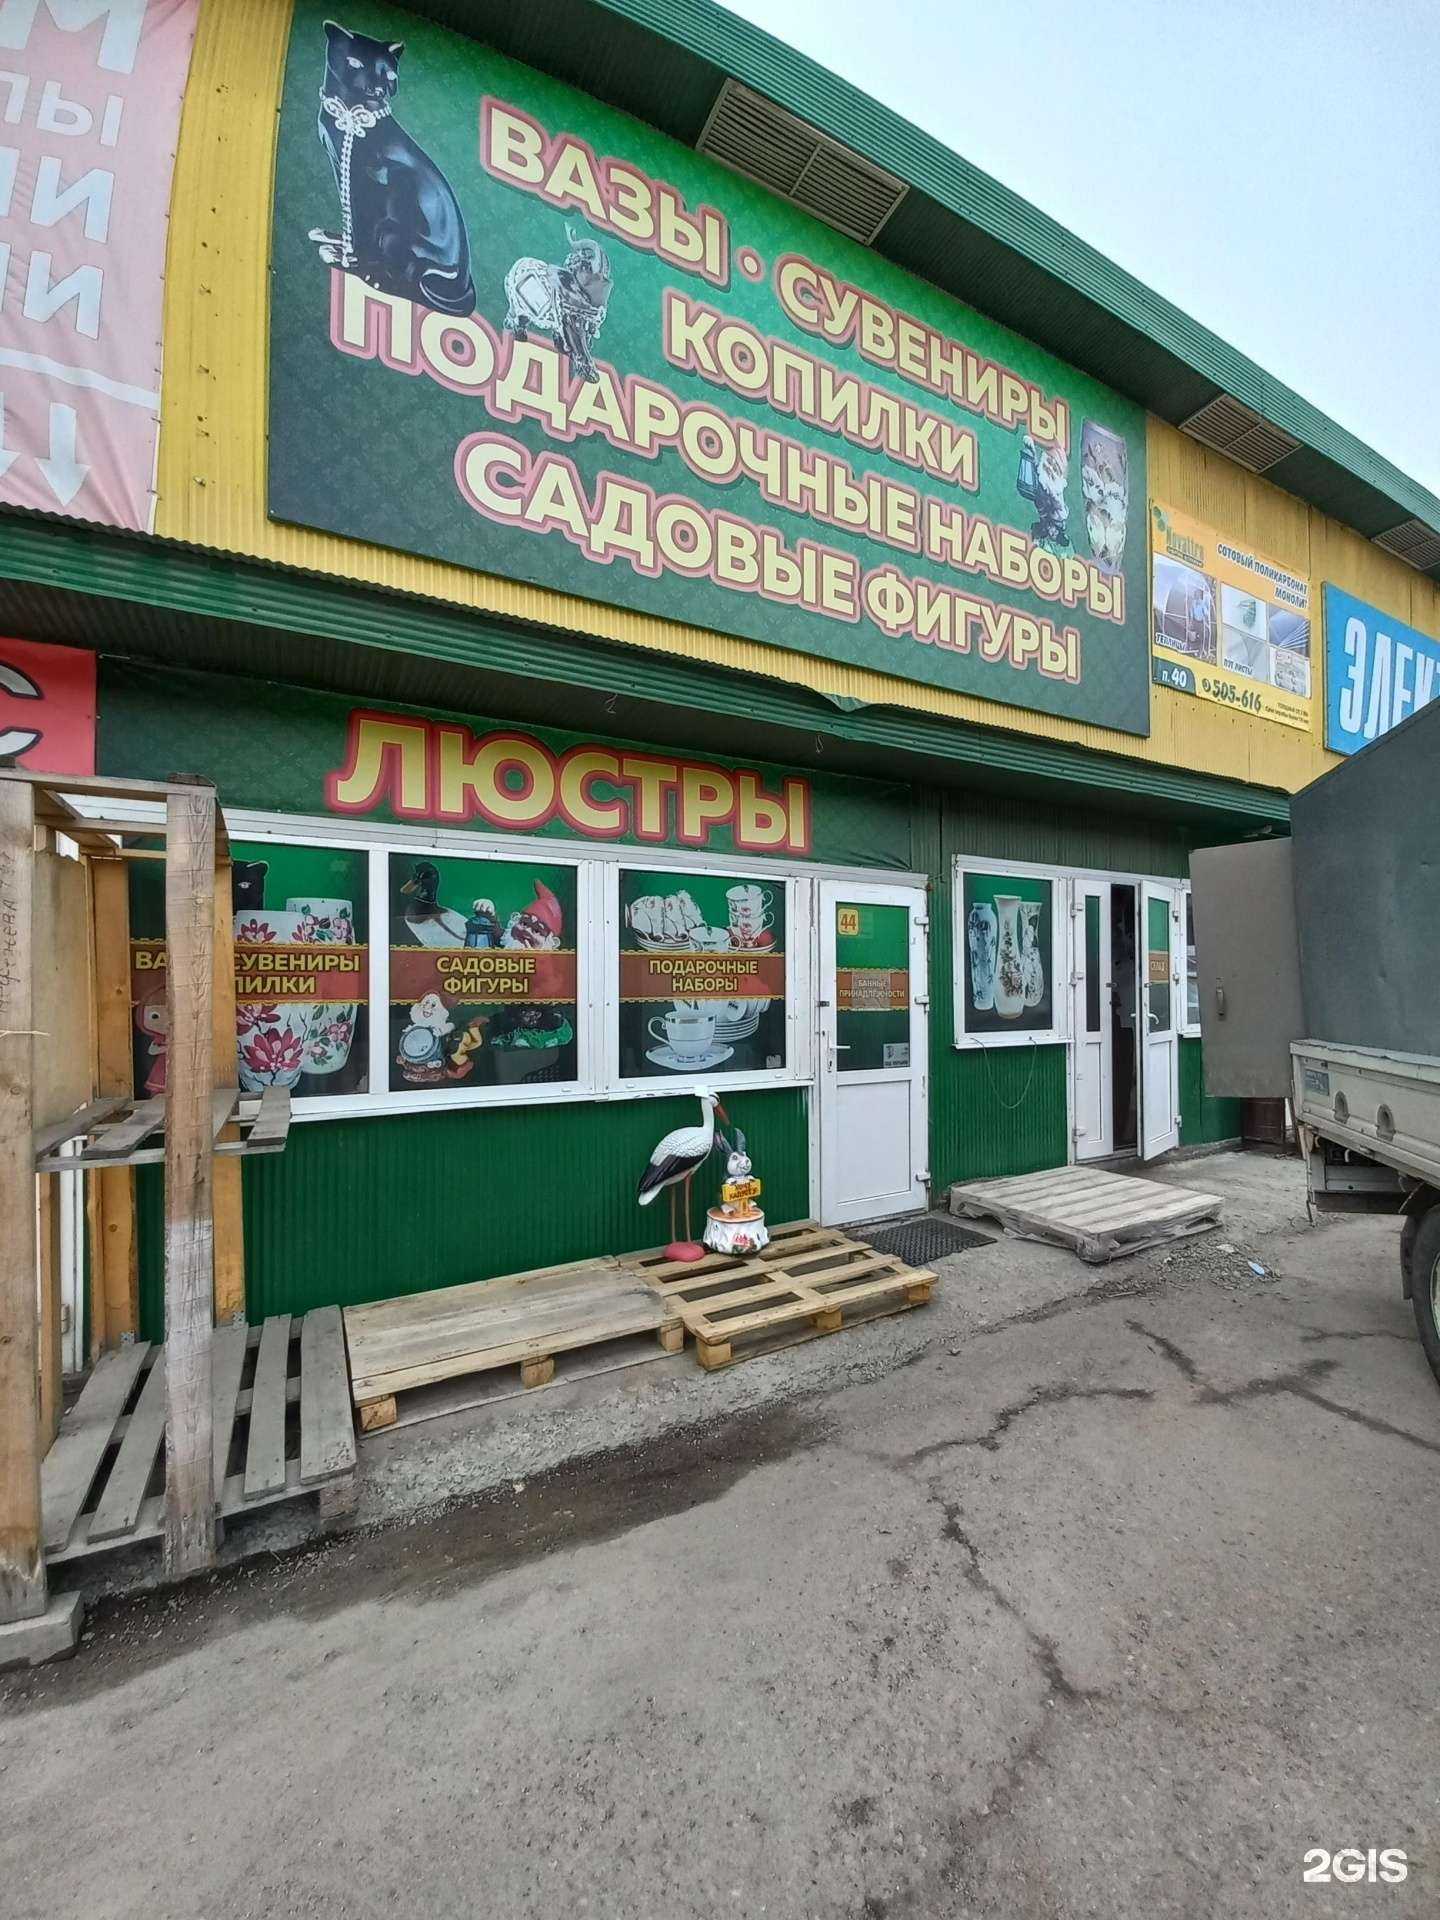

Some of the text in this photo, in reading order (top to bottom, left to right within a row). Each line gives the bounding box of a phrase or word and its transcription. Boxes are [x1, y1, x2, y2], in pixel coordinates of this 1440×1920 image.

[486, 102, 1071, 450] ВАЗЫ СУВЕНИРЫ
[667, 293, 977, 489] КОПИЛКИ
[338, 270, 1125, 624] ПОДАРОЧНЫЕ НАБОРЫ
[461, 438, 1081, 682] САДОВЫЕ ФИГУРЫ
[1218, 543, 1253, 569] СОТОВЫЙ
[1254, 561, 1308, 594] ПОЛИКАРБОНАТ
[1275, 587, 1308, 609] МОНОЛИТ
[1171, 668, 1187, 687] 40
[1340, 617, 1440, 740] ЭЛЕК
[1212, 679, 1261, 713] 505-616
[333, 715, 808, 850] ЛЮСТРЫ
[841, 913, 856, 930] 44
[437, 956, 536, 976] САДОВЫЕ
[649, 960, 759, 977] ПОДАРОЧНЫЕ
[235, 976, 316, 994] ПИЛКИ
[443, 977, 529, 995] ФИГУРЫ
[672, 977, 738, 992] НАБОРЫ
[858, 979, 887, 987] БАННЫЕ
